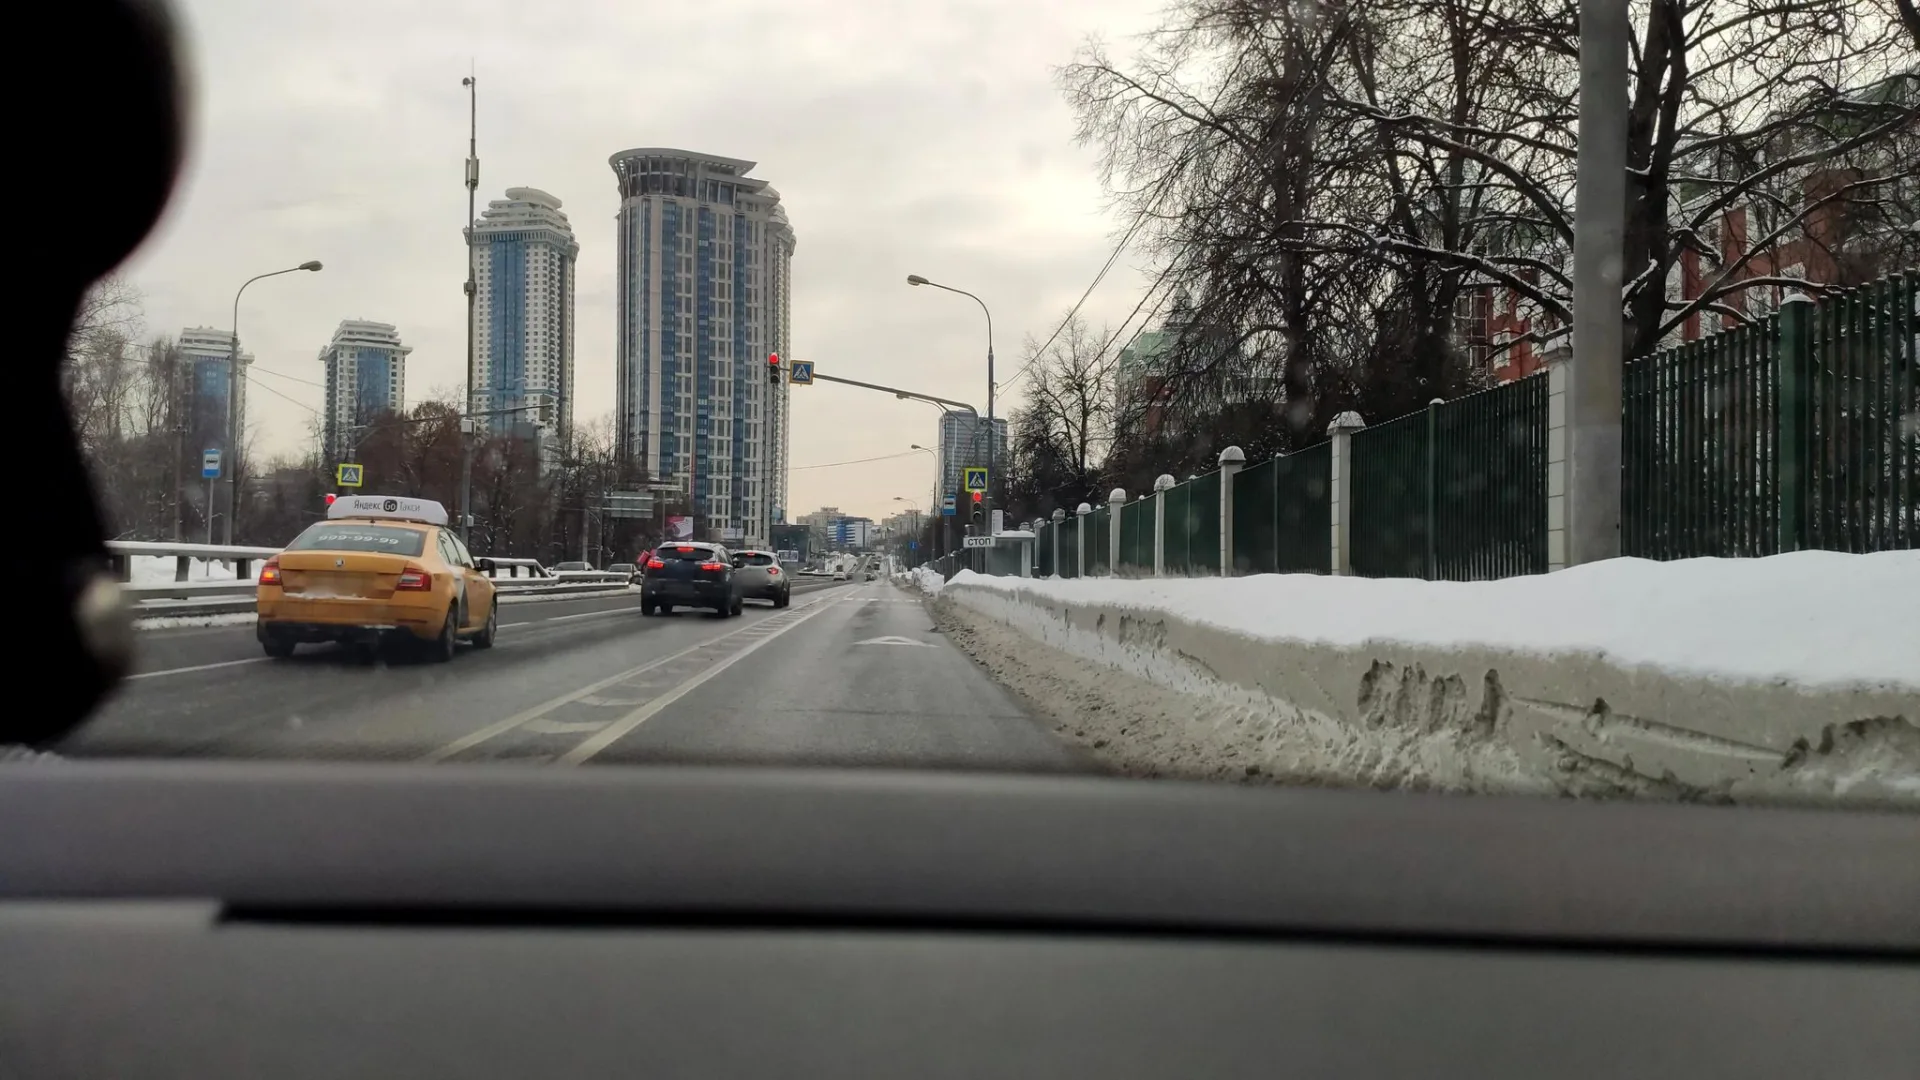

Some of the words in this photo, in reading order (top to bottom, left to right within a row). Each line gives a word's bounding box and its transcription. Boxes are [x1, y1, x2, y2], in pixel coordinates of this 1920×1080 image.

[353, 500, 381, 510] Яндекс
[384, 500, 397, 511] Go
[399, 501, 421, 512] Такси
[318, 535, 399, 545] 999-99-99
[968, 537, 991, 546] СТОП
